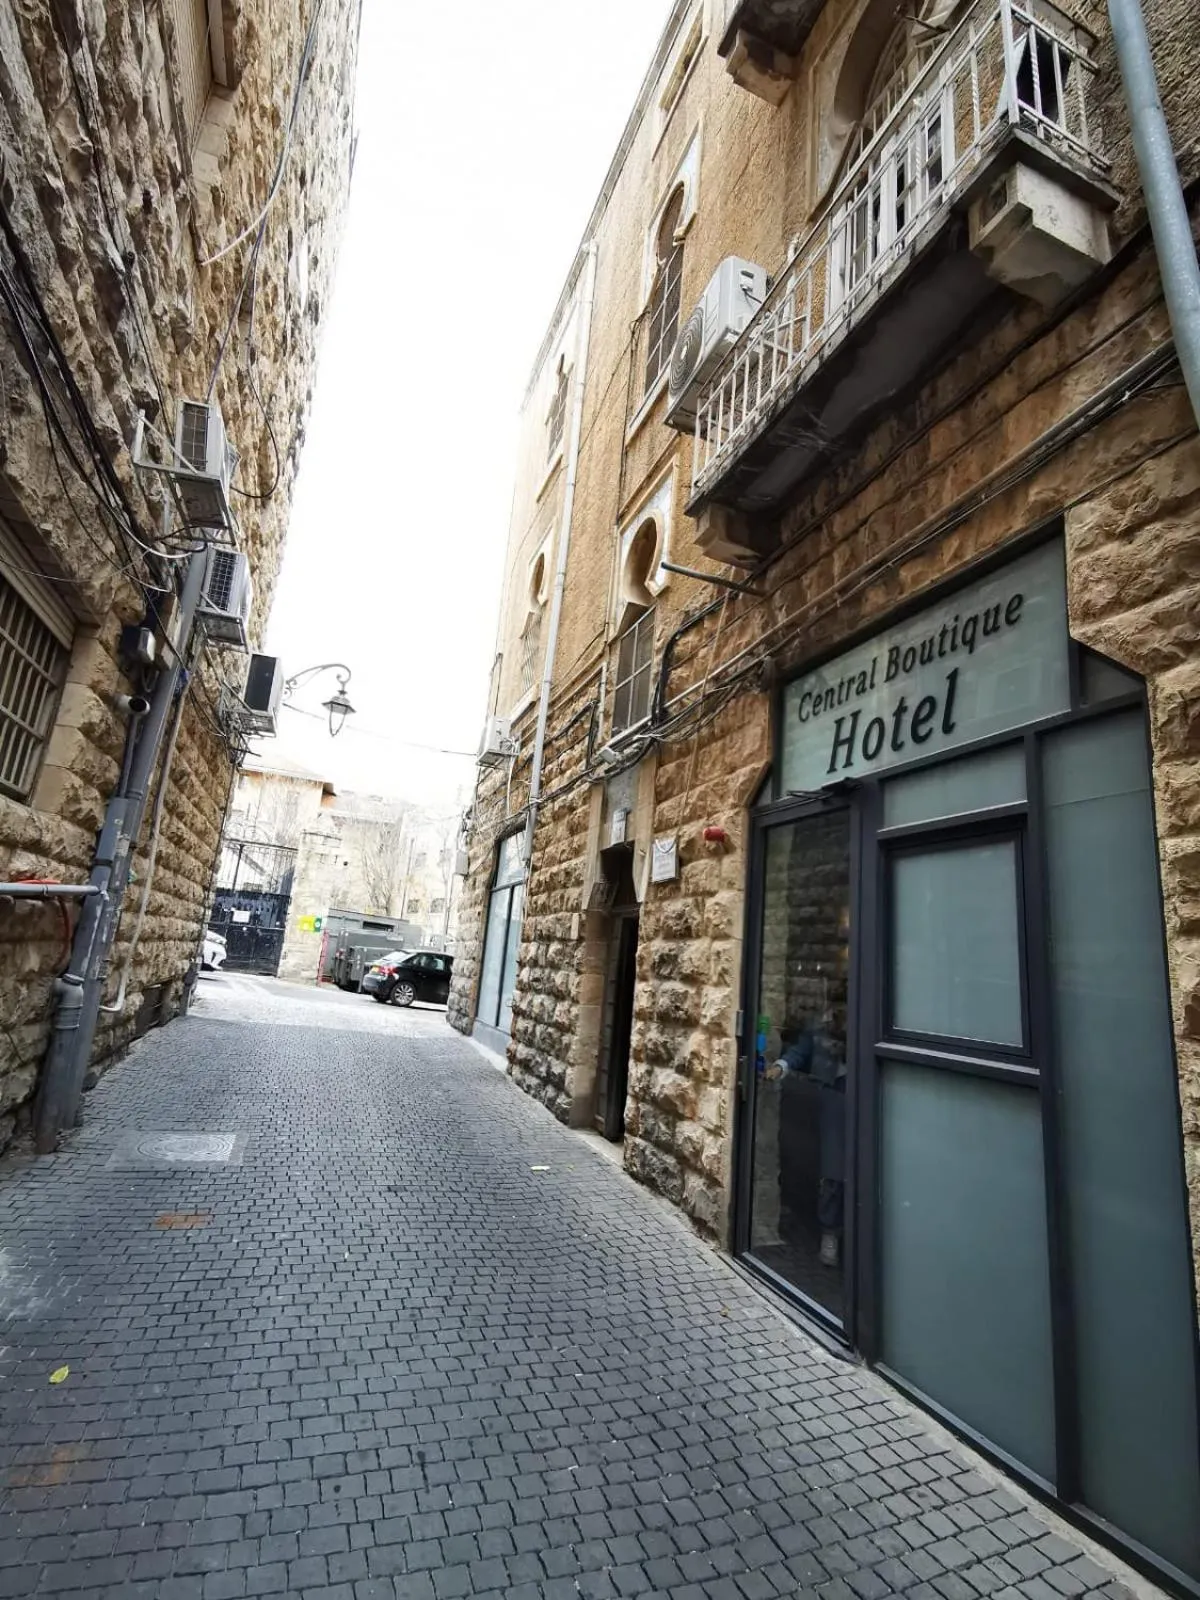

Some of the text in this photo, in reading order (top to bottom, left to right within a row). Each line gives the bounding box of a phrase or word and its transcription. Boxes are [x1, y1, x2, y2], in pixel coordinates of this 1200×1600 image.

[798, 593, 1024, 722] Central Boutique
[826, 668, 959, 773] Hotel
